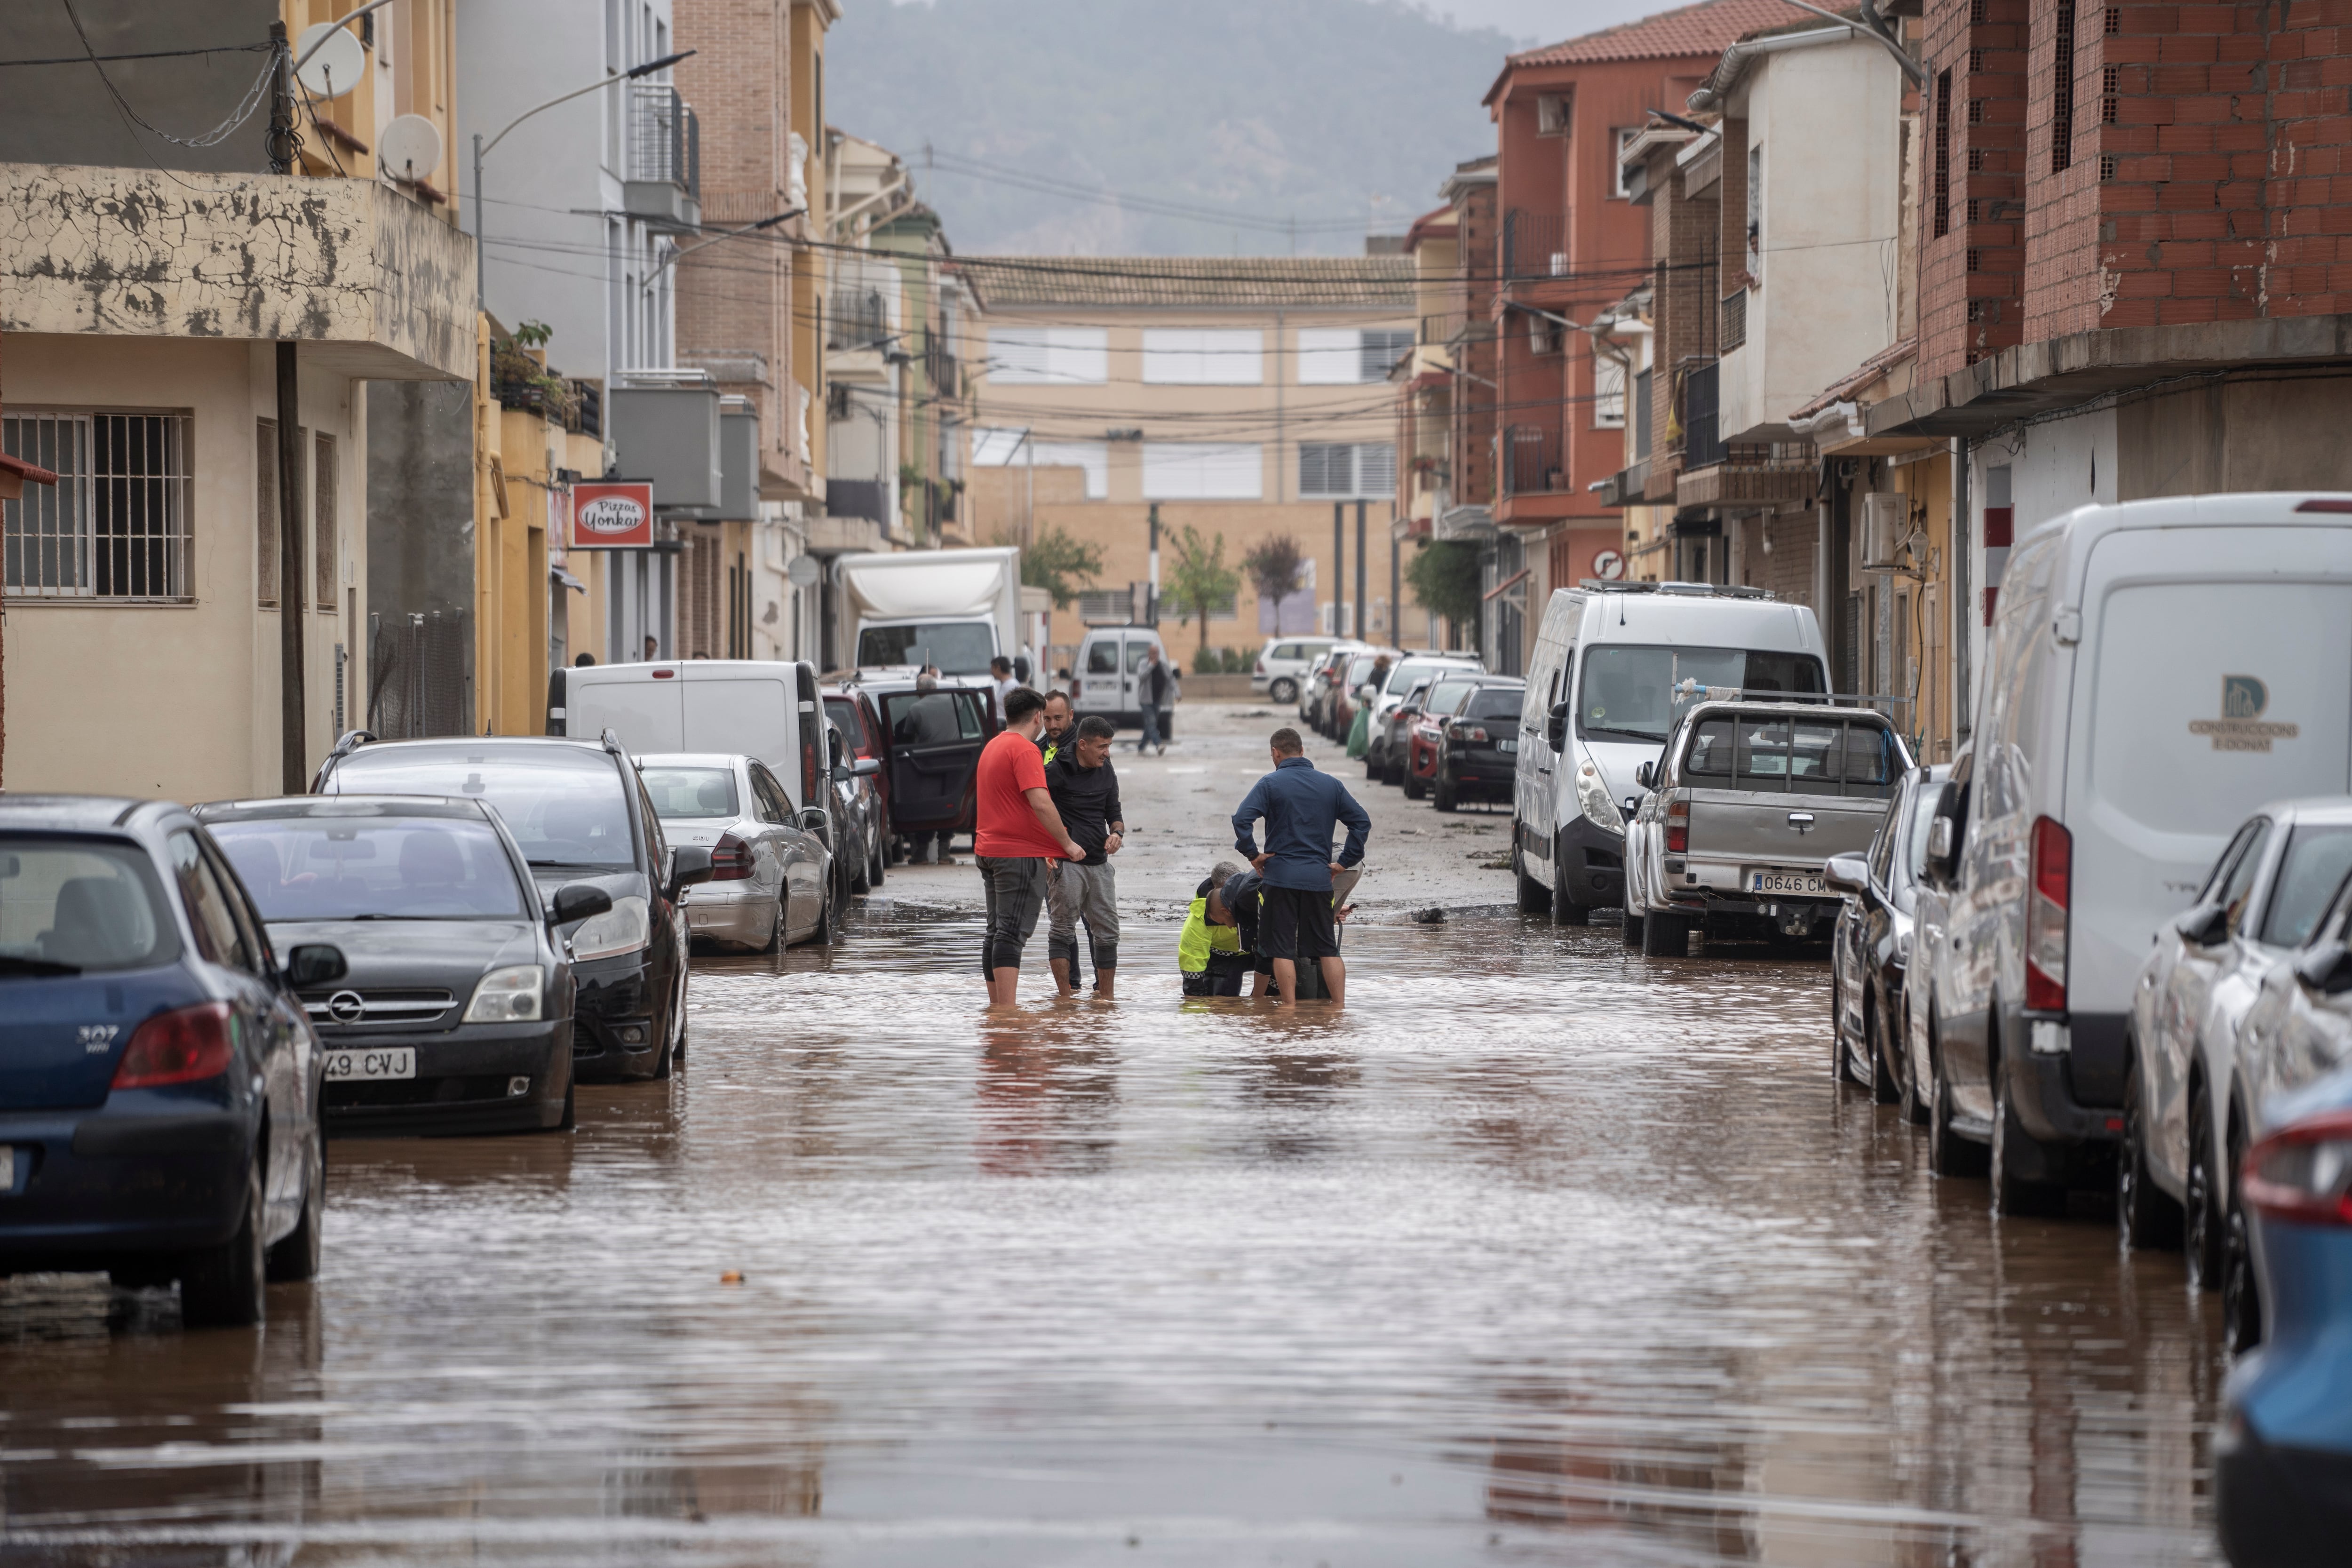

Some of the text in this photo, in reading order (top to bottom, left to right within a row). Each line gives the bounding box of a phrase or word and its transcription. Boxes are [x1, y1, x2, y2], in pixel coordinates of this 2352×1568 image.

[597, 501, 637, 513] Pizzas
[585, 511, 640, 531] Yonkar
[2189, 721, 2298, 737] CONSTRUCCIONS
[1764, 876, 1834, 893] 0646 CM
[75, 1024, 119, 1044] 307
[366, 1053, 407, 1075] CVJ
